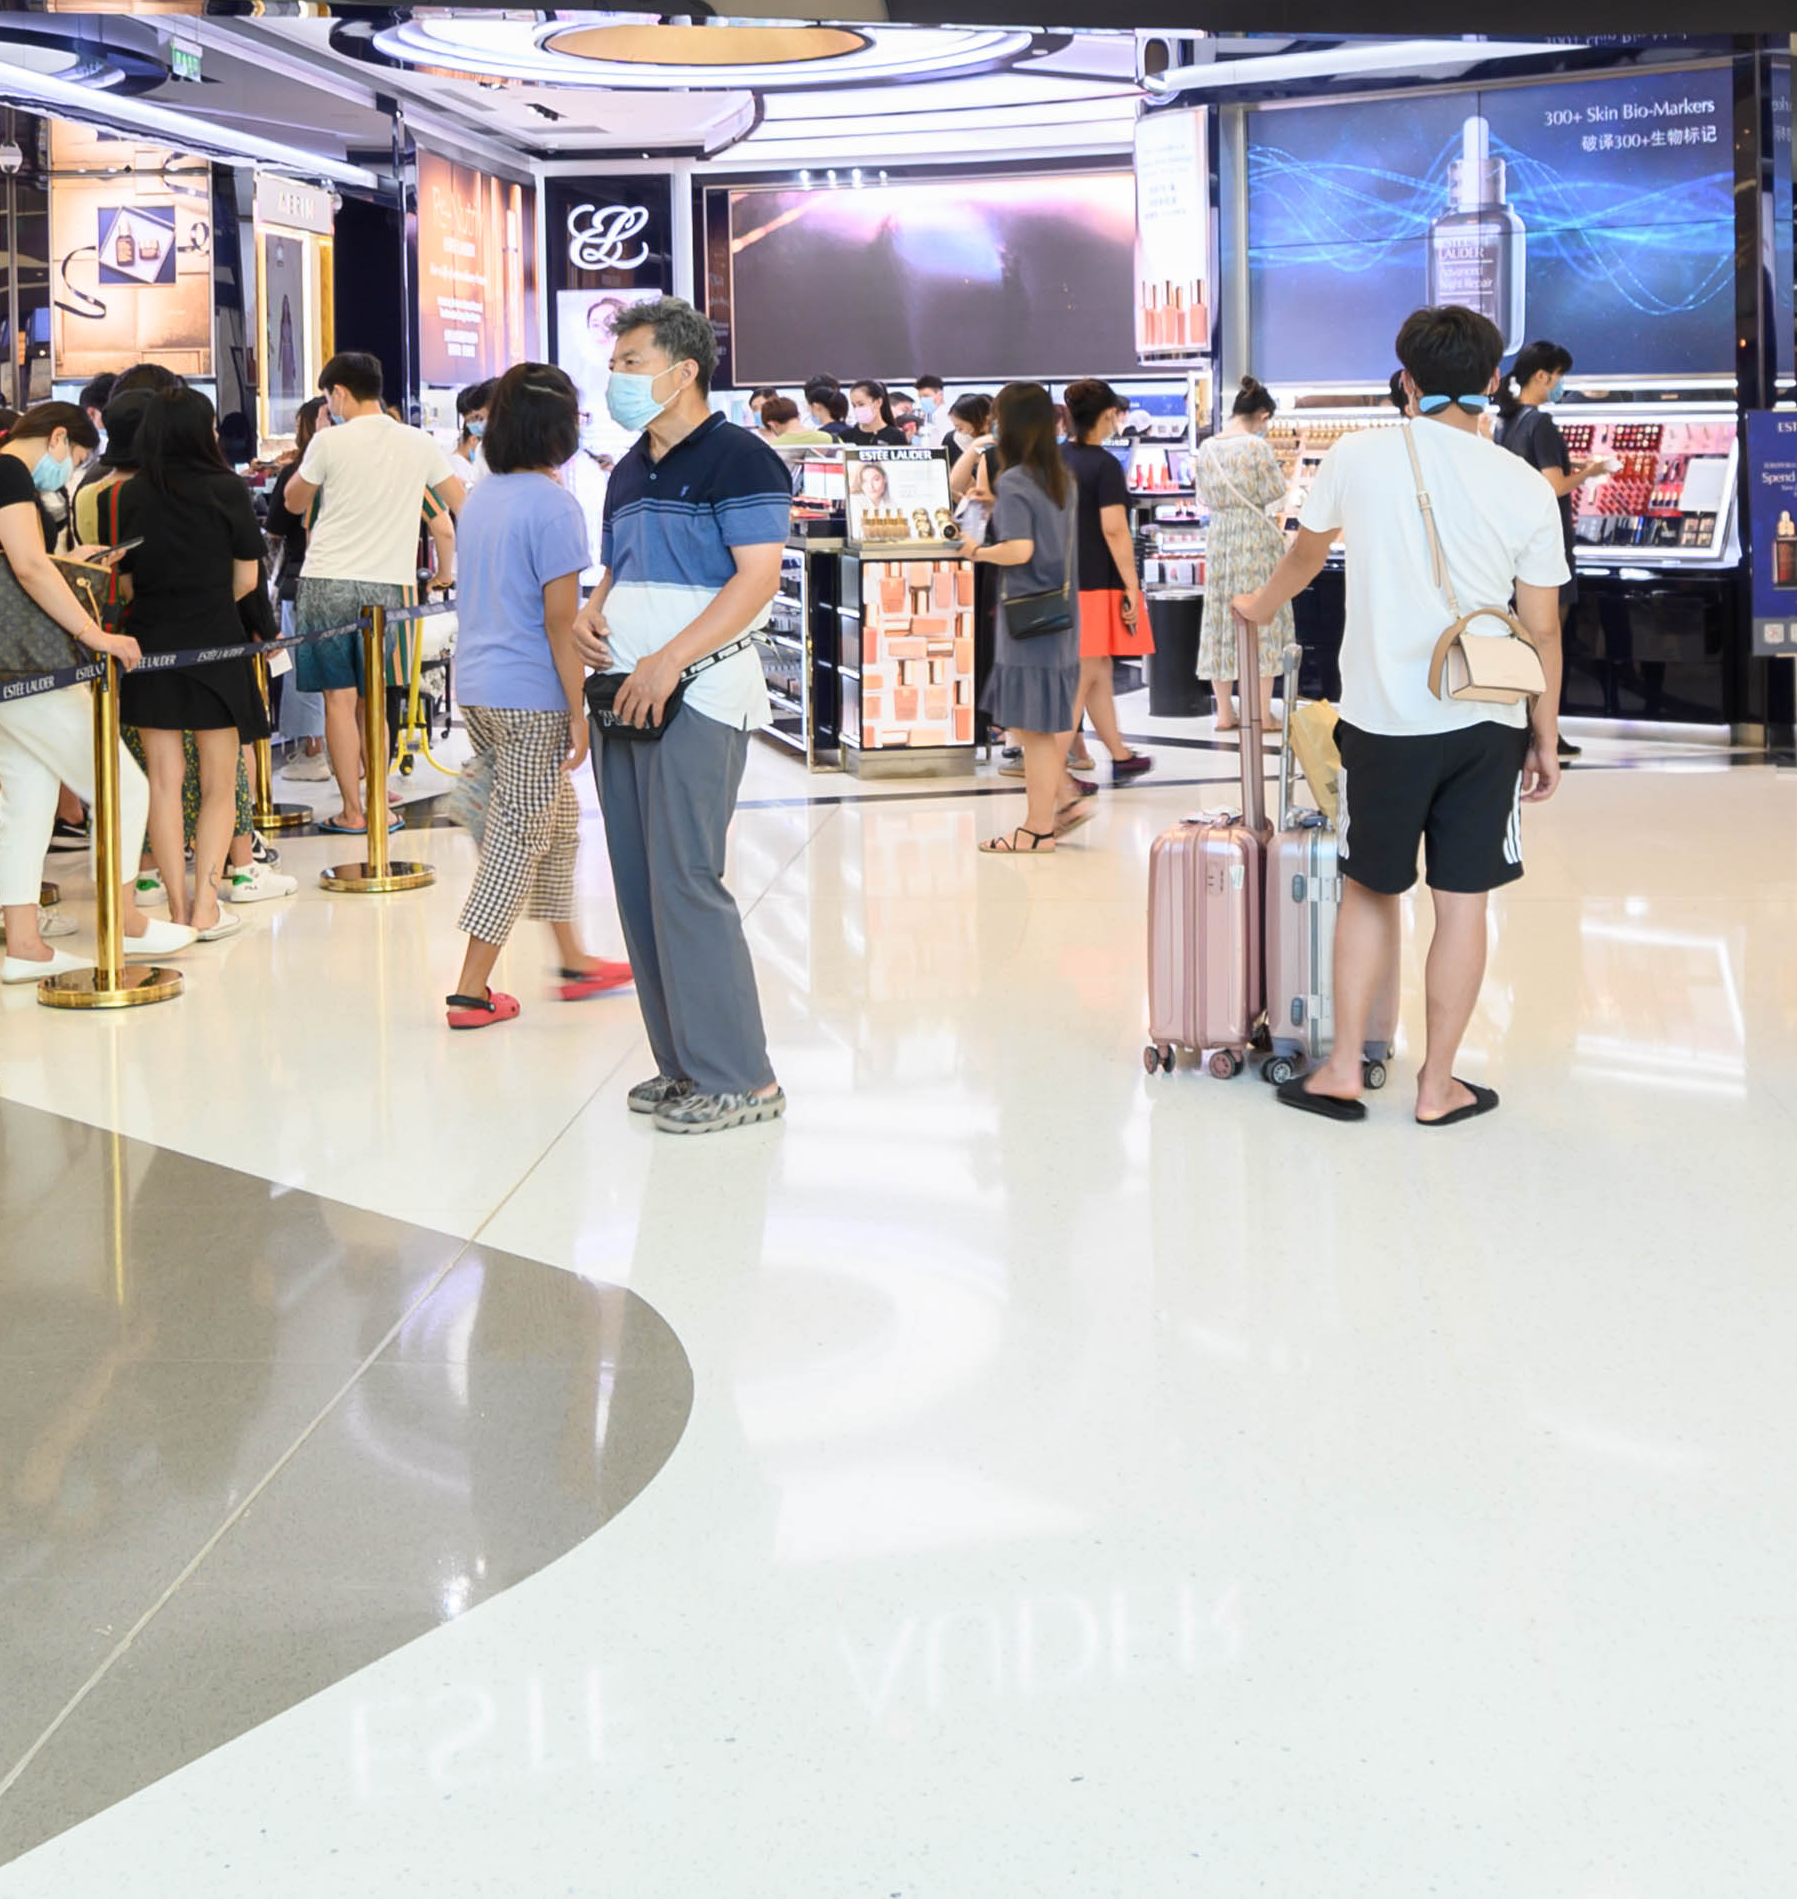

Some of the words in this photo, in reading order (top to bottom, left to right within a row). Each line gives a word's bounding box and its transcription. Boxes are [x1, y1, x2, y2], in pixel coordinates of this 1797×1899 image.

[1544, 109, 1583, 127] 300+
[1586, 104, 1619, 123] Skin
[1623, 96, 1716, 121] Bio-Markers
[890, 449, 932, 460] LAUDER
[25, 675, 55, 694] LAUDER
